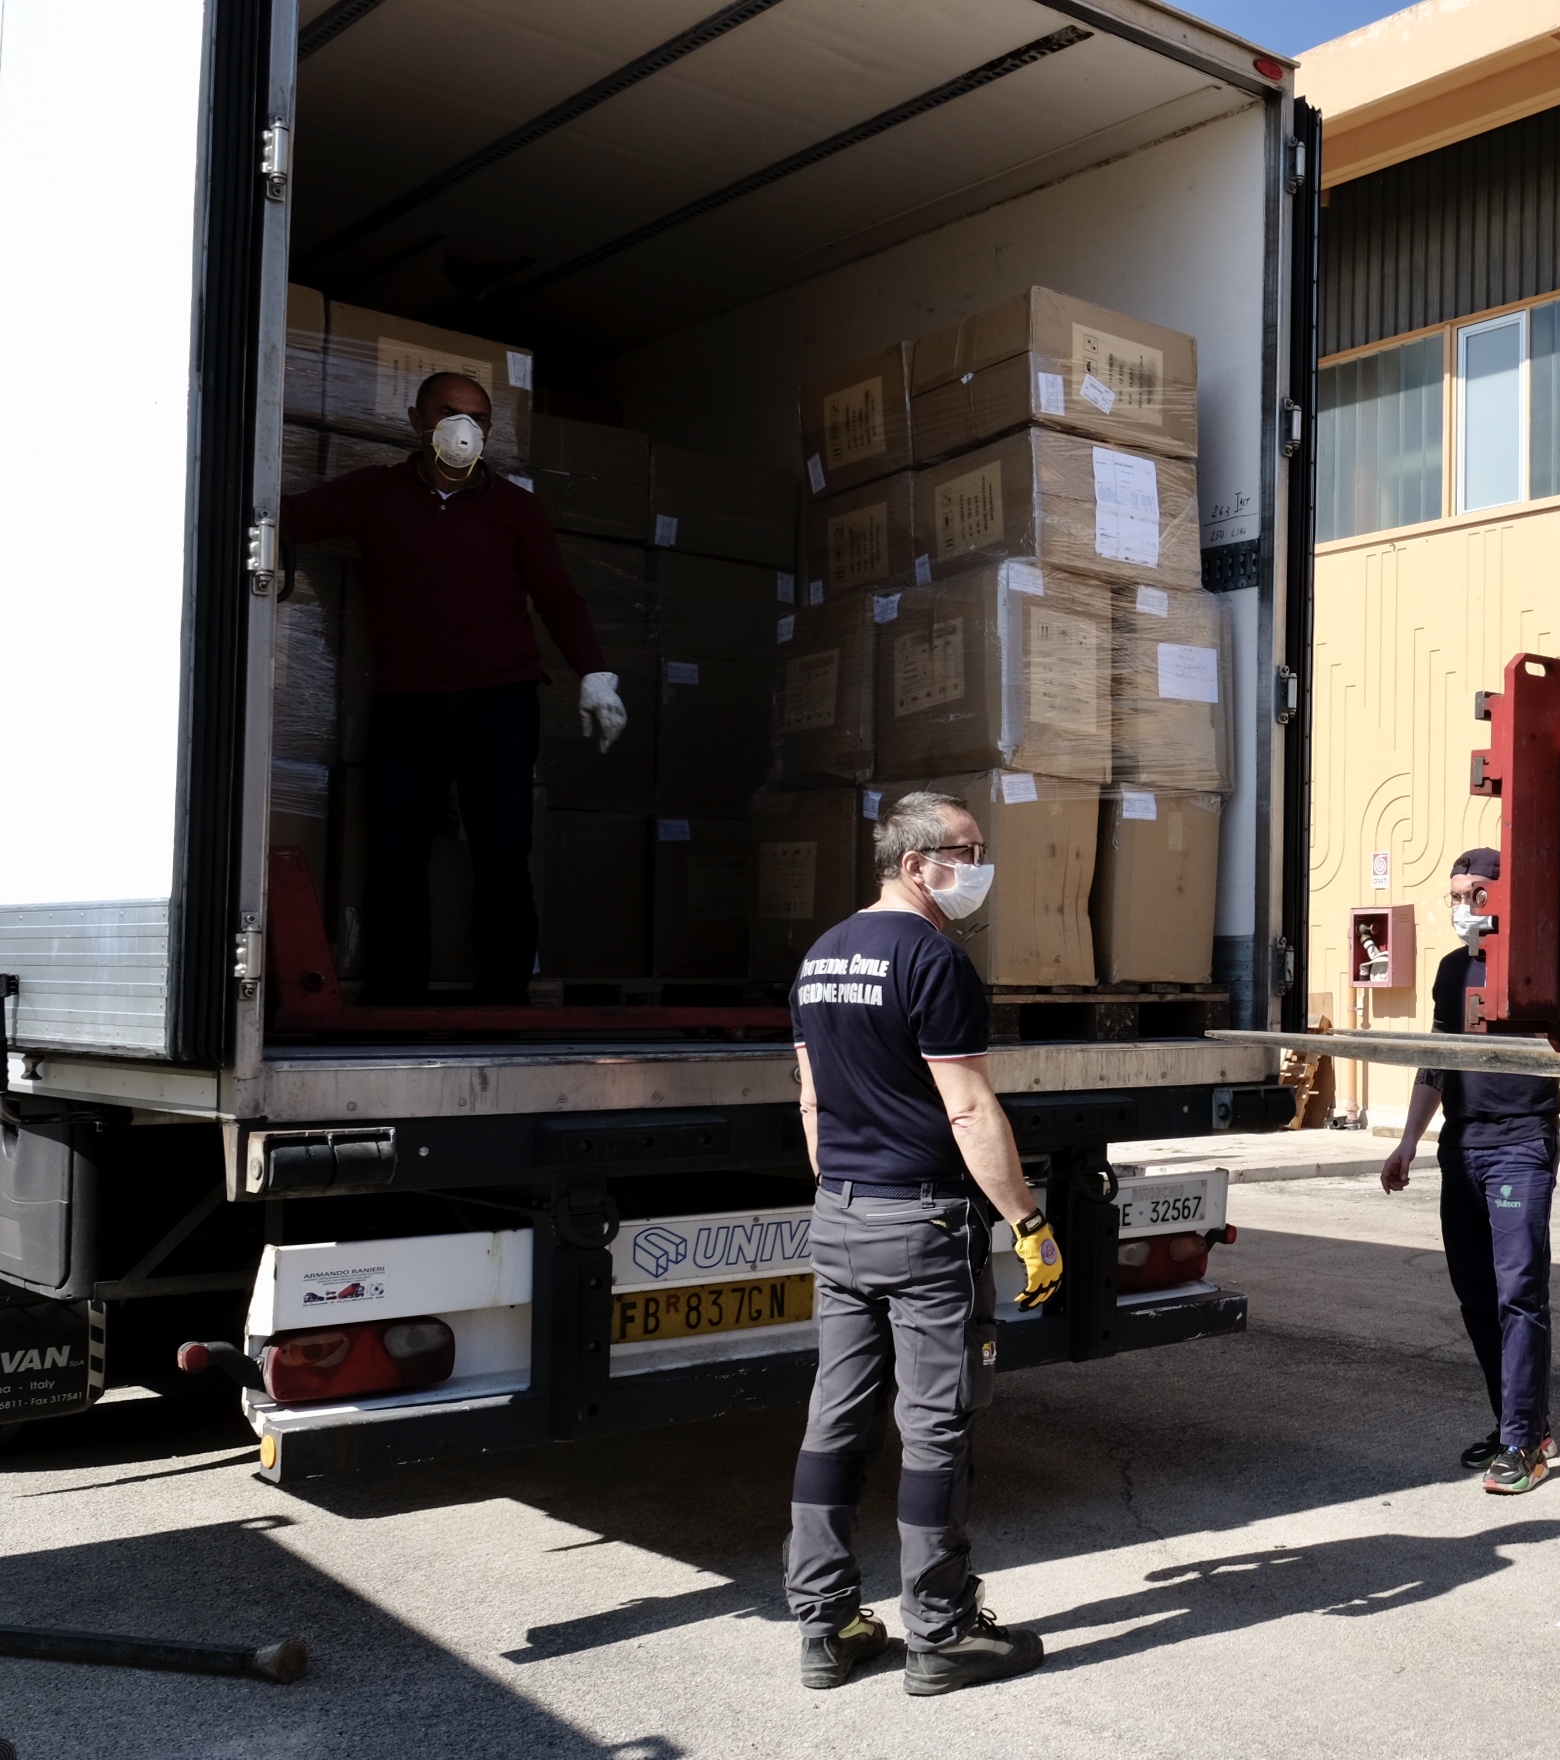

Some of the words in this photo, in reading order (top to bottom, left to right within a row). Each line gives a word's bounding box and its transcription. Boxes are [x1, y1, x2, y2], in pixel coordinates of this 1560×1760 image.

[837, 982, 883, 1006] PUGLIA
[1150, 1196, 1202, 1223] 32567
[303, 1269, 350, 1279] ARMANDO
[351, 1266, 385, 1275] RANIERI
[30, 1380, 55, 1390] Italy
[31, 1397, 47, 1406] Fax
[50, 1391, 82, 1404] 317541
